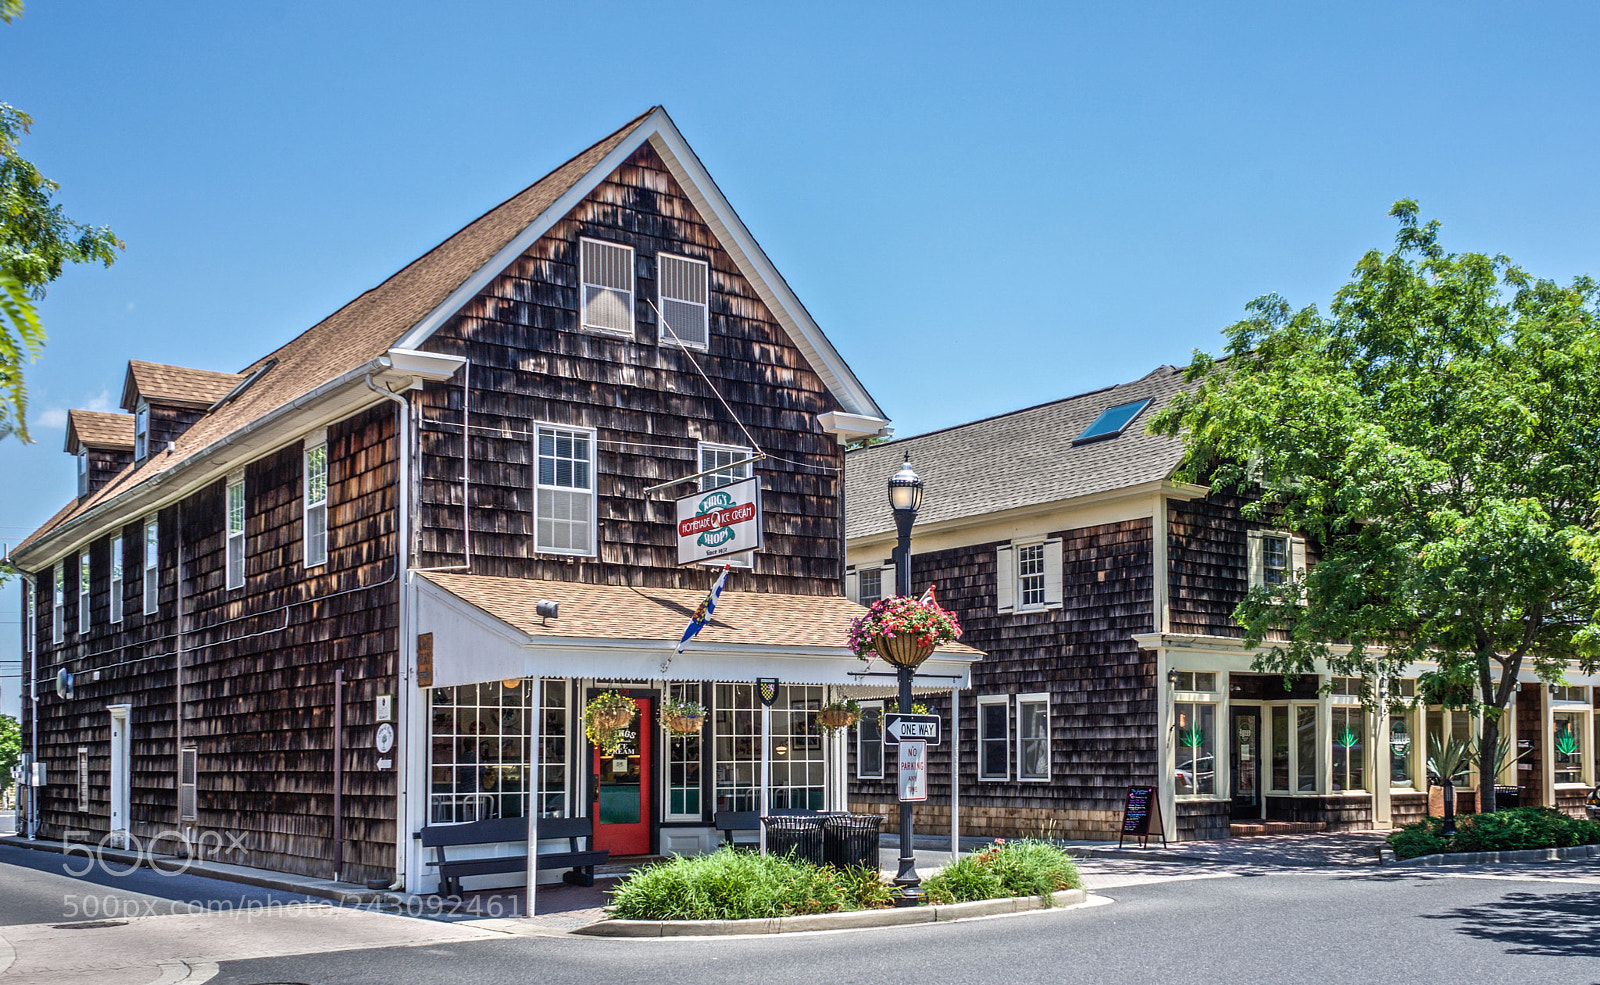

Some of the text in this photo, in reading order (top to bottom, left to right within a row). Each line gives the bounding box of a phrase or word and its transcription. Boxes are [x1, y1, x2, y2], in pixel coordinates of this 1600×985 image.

[682, 506, 752, 534] HOMEMADE ICE CREAM
[901, 723, 934, 736] ONE WAY
[908, 748, 917, 757] NO
[901, 762, 923, 770] PARKING
